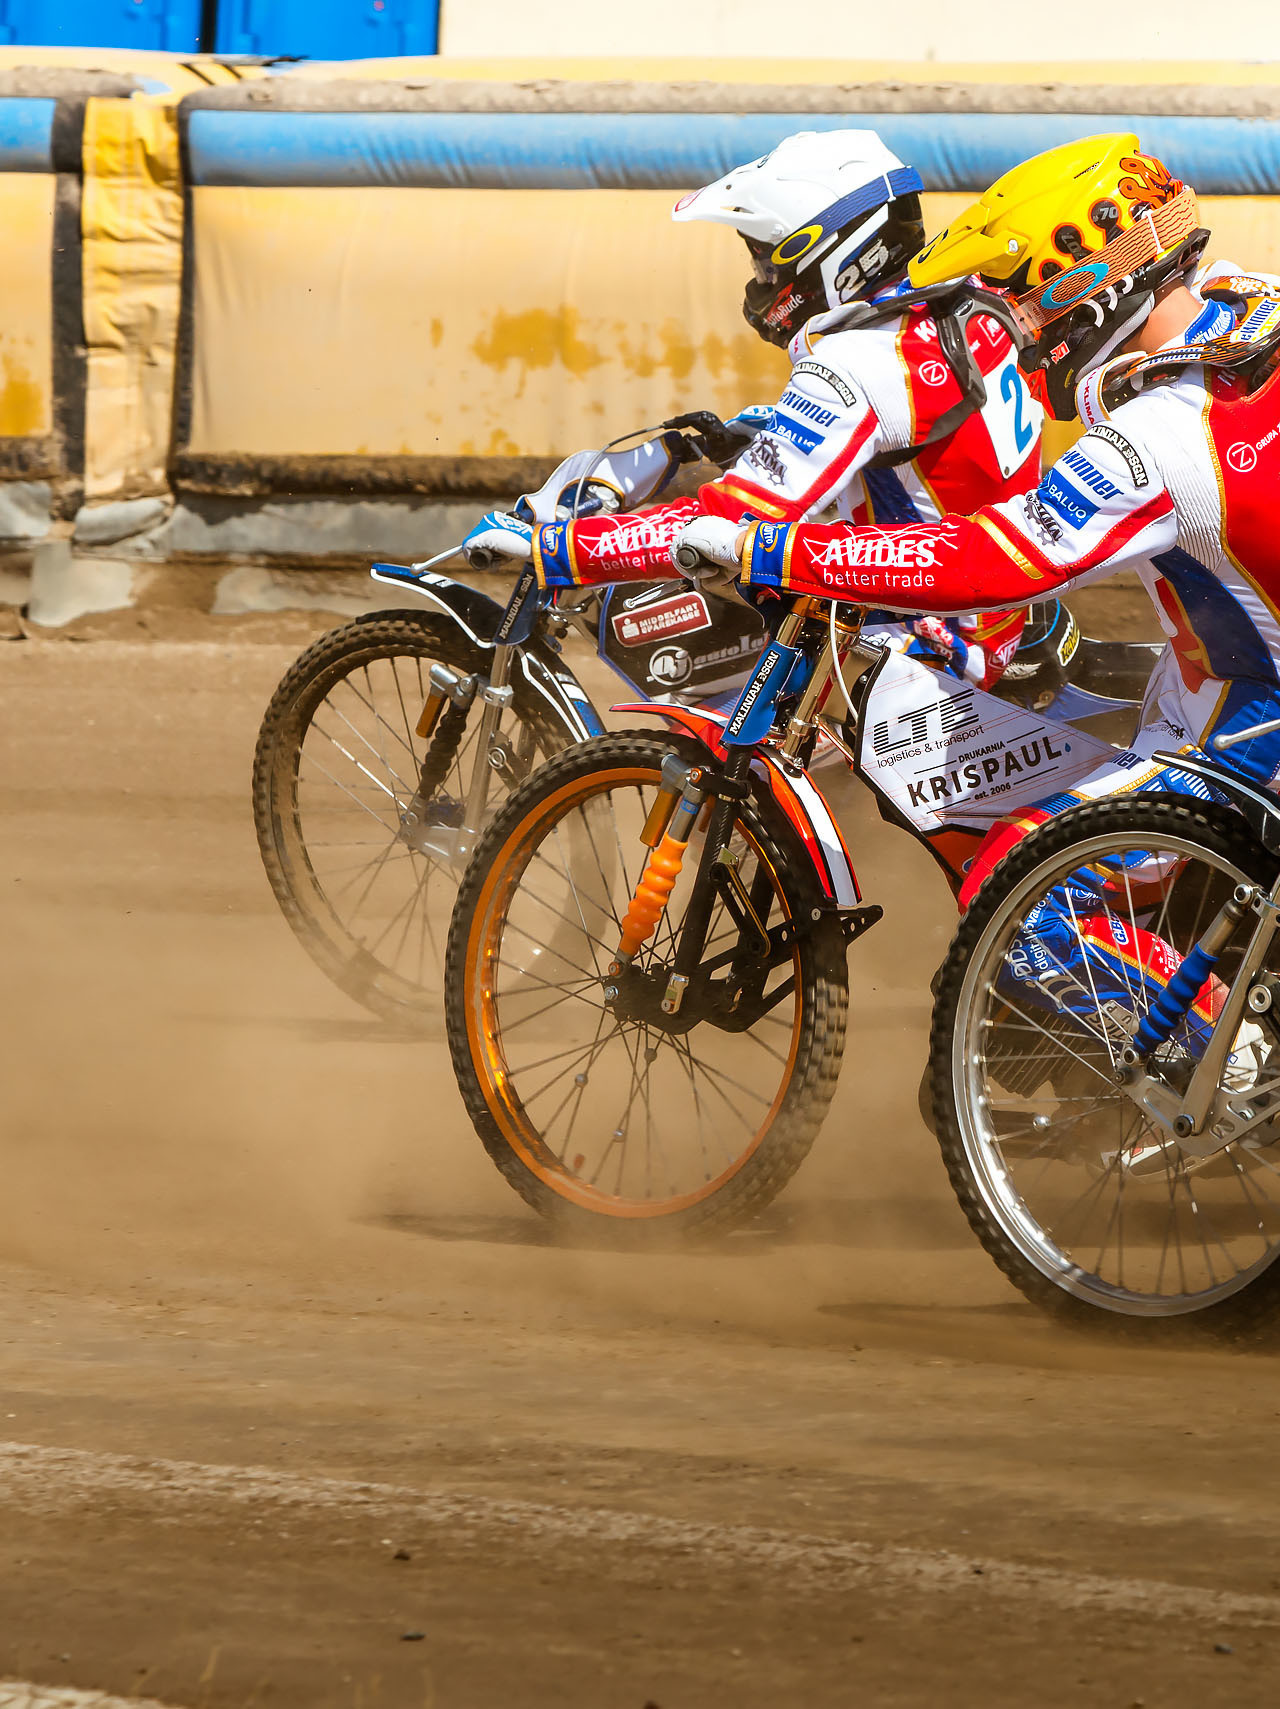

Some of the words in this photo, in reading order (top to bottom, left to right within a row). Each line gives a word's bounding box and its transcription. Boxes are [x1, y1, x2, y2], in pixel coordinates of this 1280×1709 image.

[836, 238, 890, 302] 25
[1001, 364, 1033, 453] 2
[1256, 429, 1279, 451] GRUPA
[600, 555, 648, 572] better
[824, 537, 937, 568] AVIDES
[823, 571, 880, 587] better
[884, 570, 936, 587] trade
[873, 689, 979, 756] LTE
[876, 747, 923, 769] logistics
[924, 742, 934, 754] &
[935, 724, 985, 750] transport
[958, 742, 1006, 764] DRUKARNIA
[907, 735, 1063, 808] KRISPAUL
[990, 781, 1012, 797] 2006
